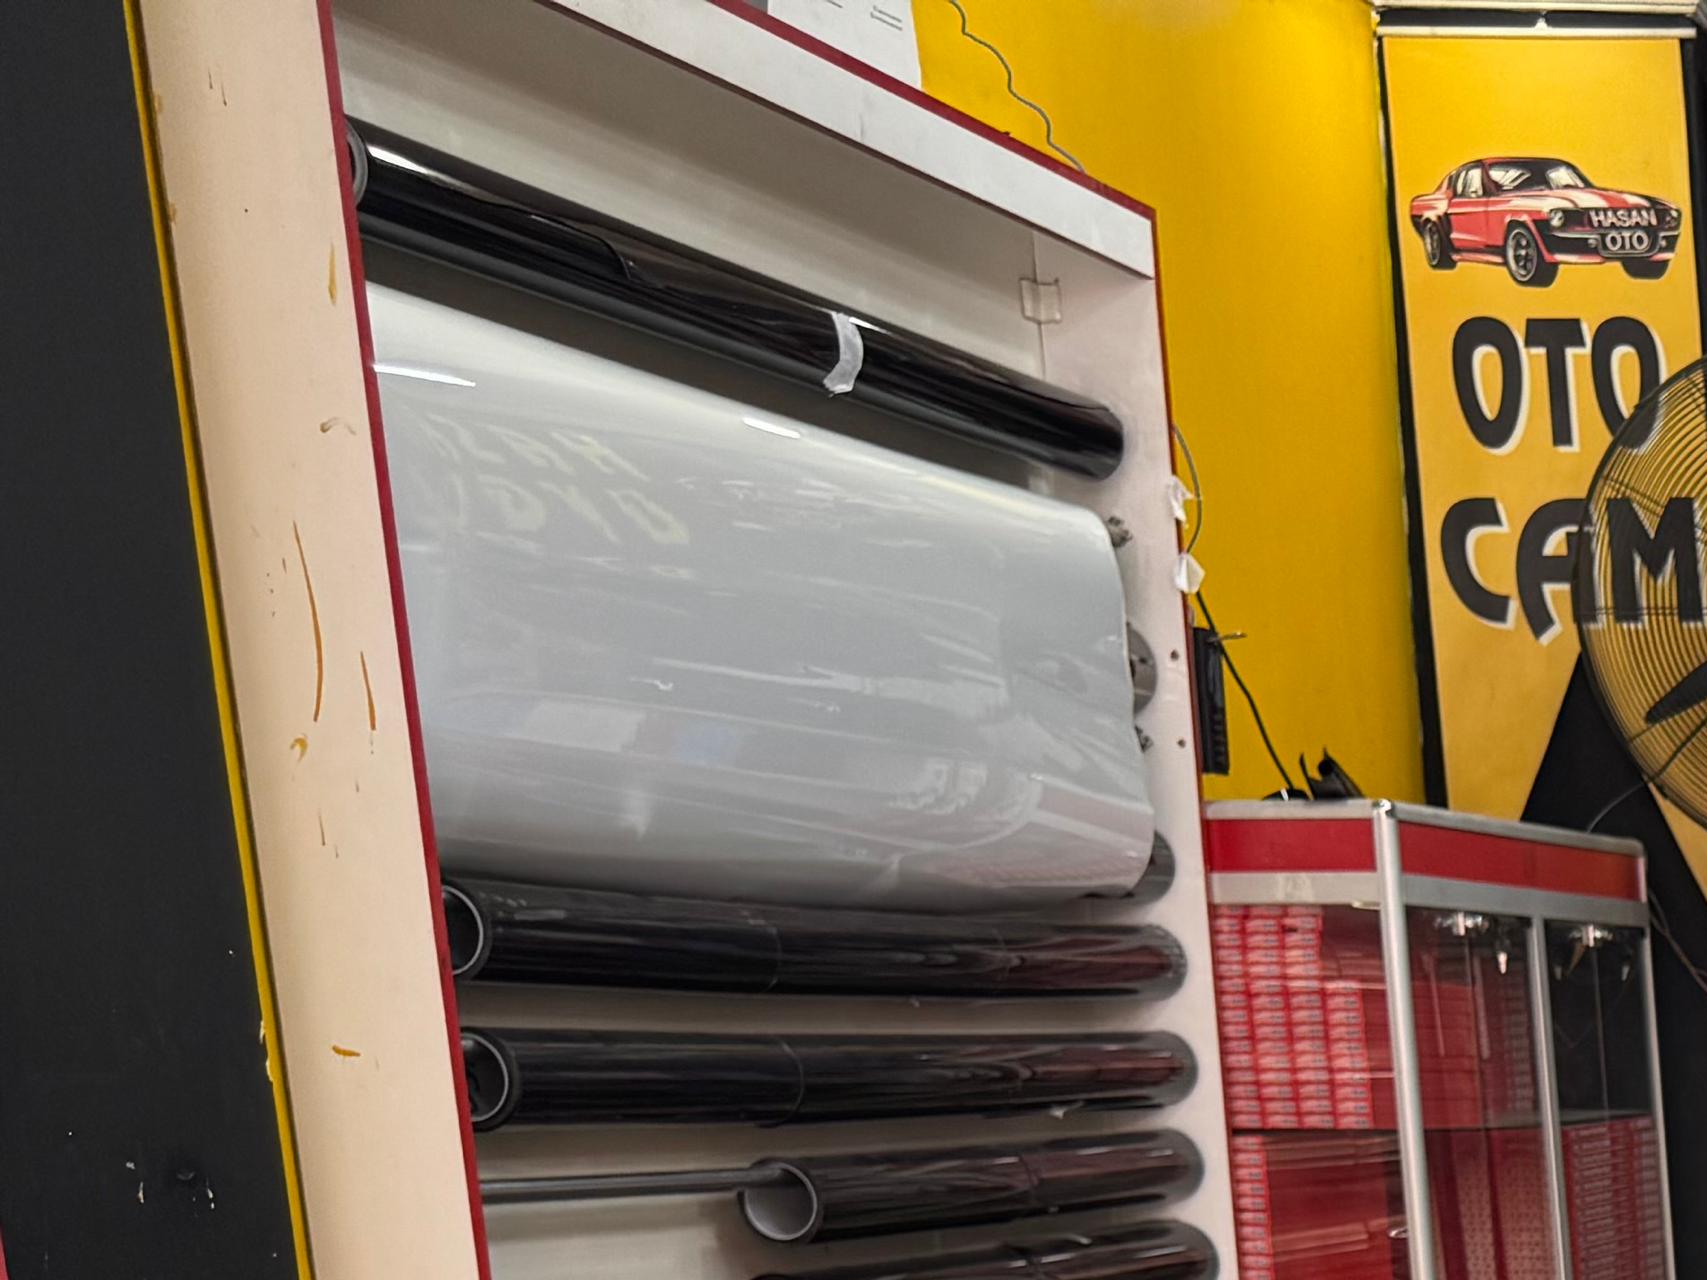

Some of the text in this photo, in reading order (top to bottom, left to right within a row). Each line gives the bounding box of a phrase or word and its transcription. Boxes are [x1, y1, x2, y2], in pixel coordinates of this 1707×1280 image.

[1589, 208, 1657, 228] HASAN
[1605, 231, 1649, 250] OTO
[1452, 316, 1664, 455] OTO
[1441, 496, 1703, 643] CAM
